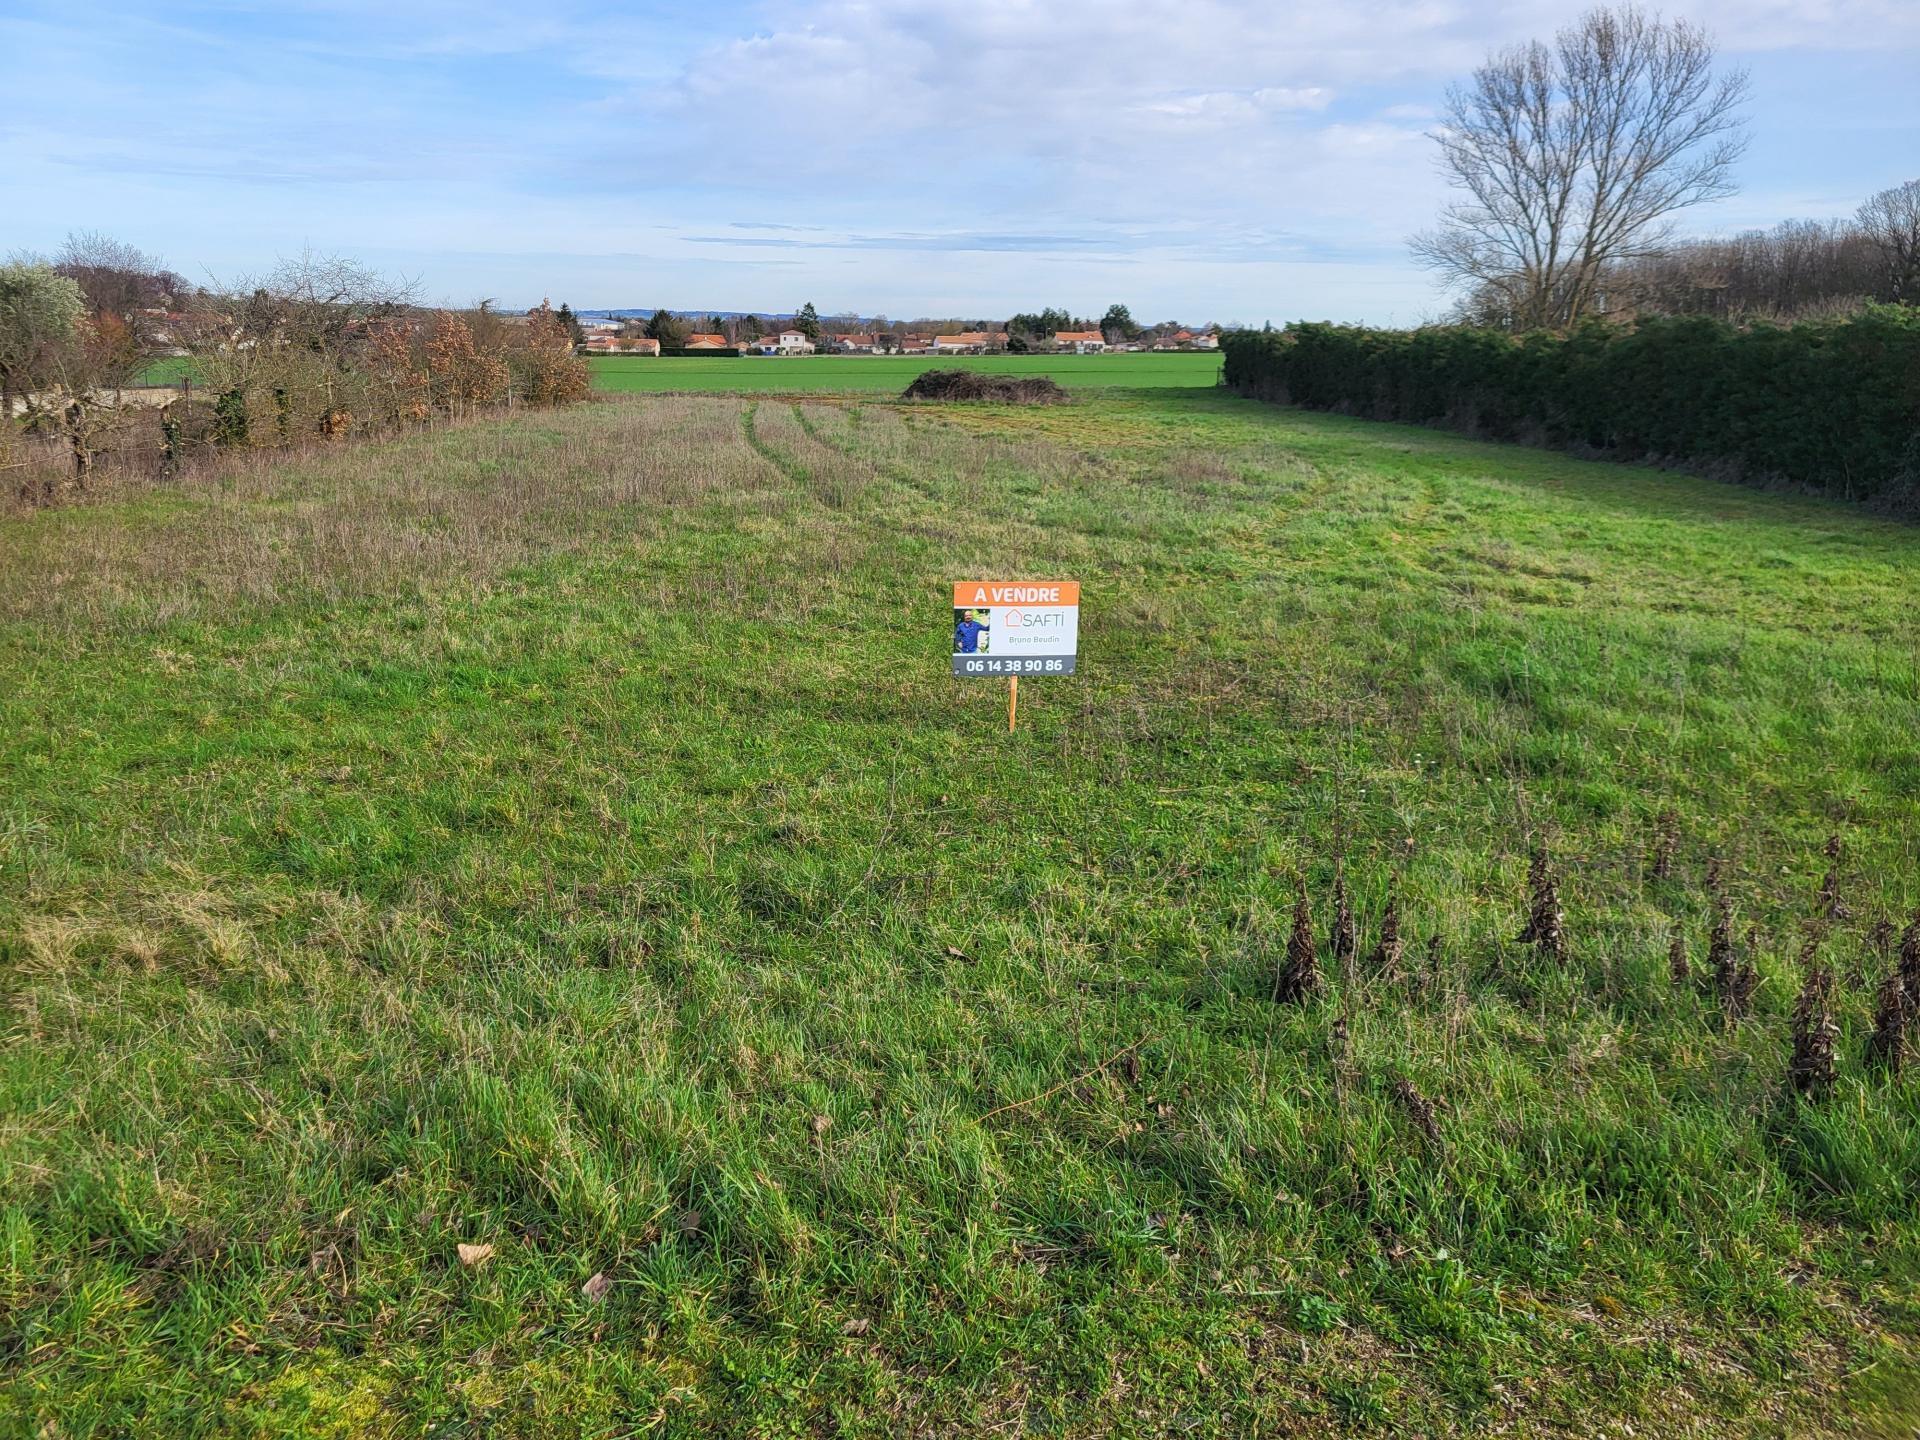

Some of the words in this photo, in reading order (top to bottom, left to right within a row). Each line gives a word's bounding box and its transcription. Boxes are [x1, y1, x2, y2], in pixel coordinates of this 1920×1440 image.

[974, 588, 987, 602] A
[991, 588, 1060, 602] VENDRE
[1009, 636, 1031, 644] Bruno
[966, 661, 984, 672] 06
[987, 661, 1002, 672] 14
[1004, 661, 1022, 672] 38
[1025, 661, 1042, 672] 90
[1045, 660, 1062, 671] 86
